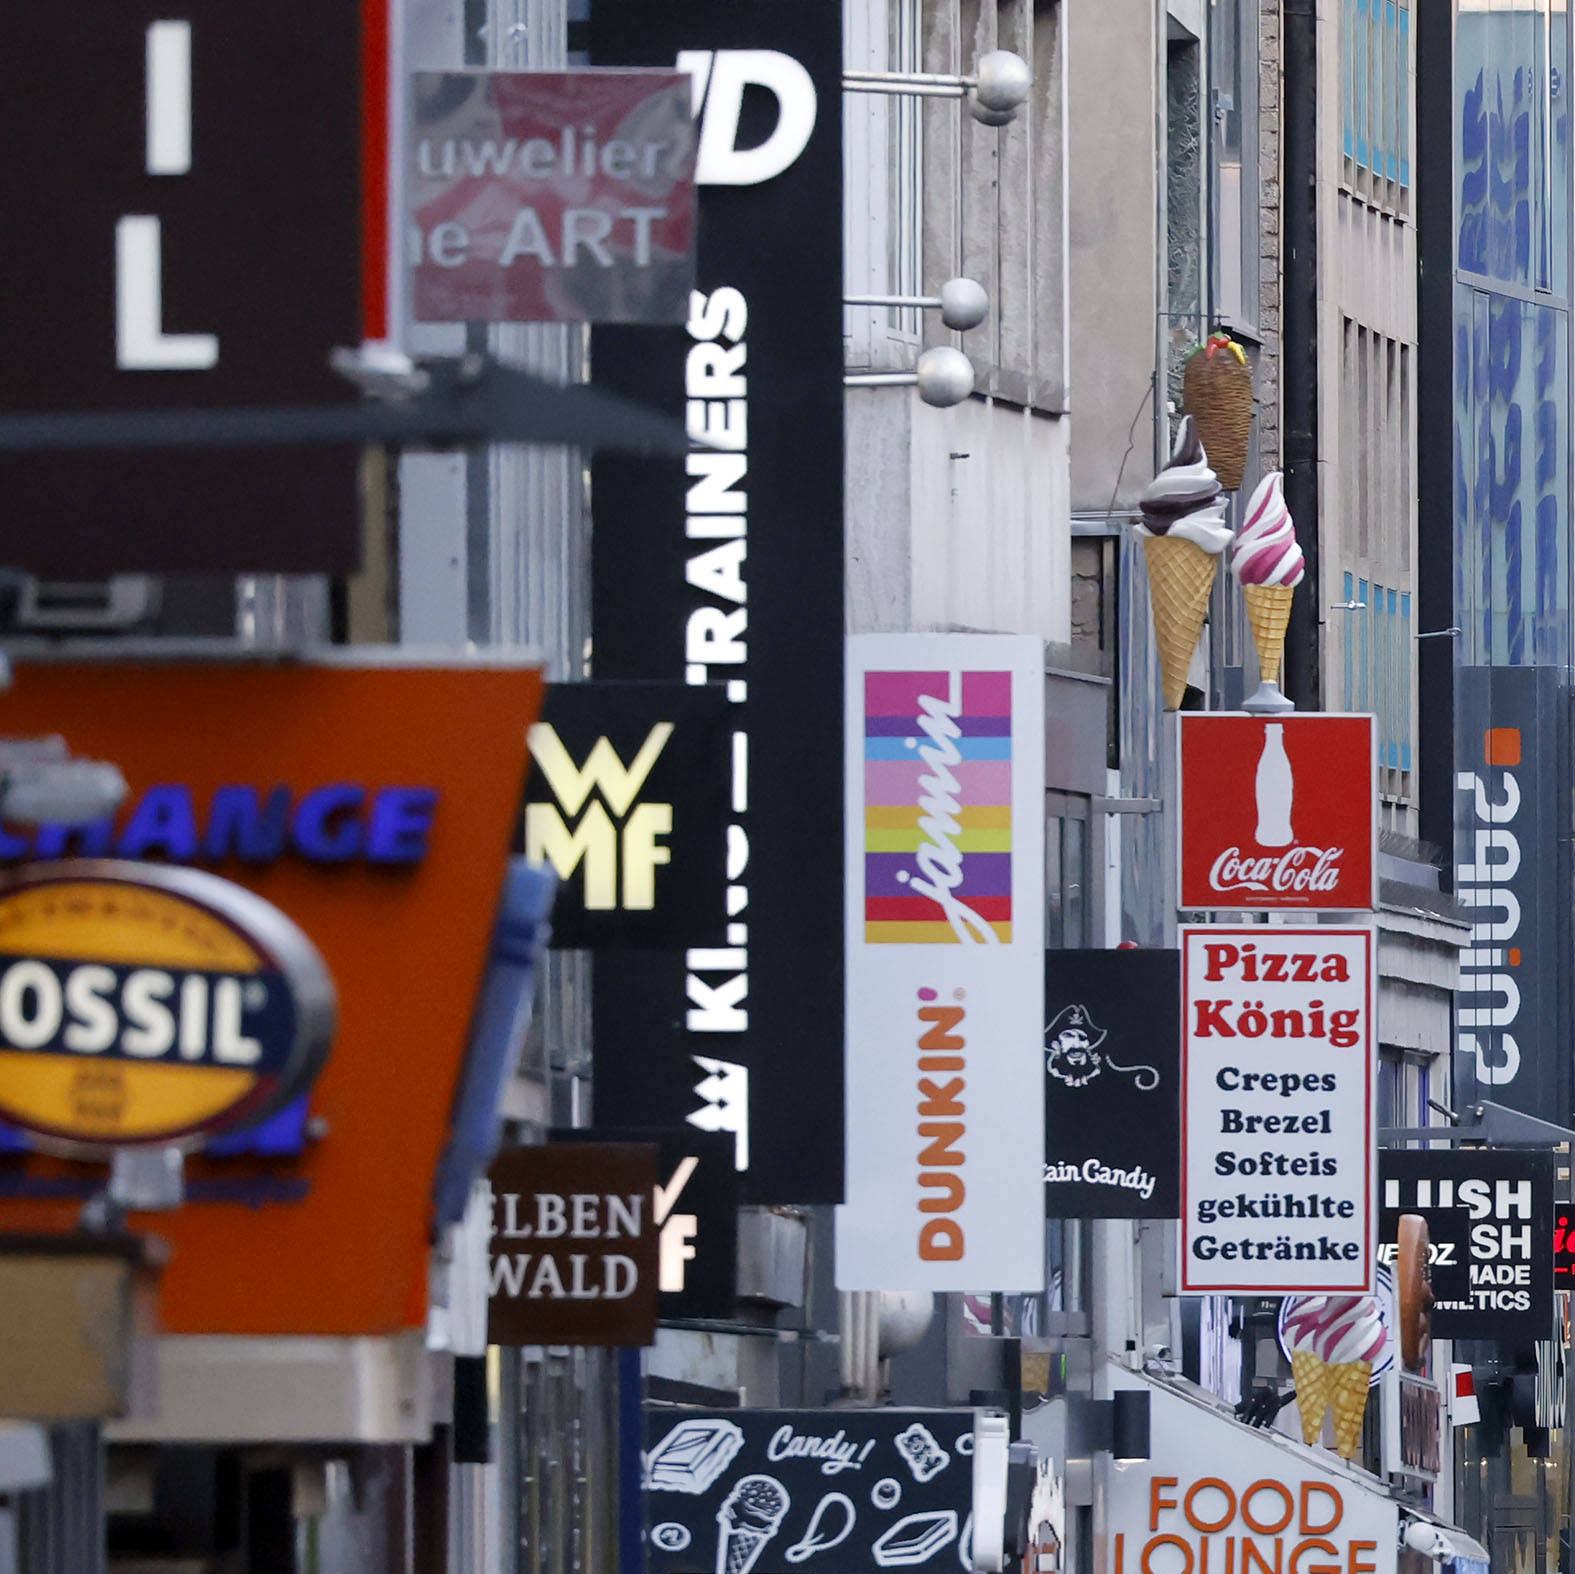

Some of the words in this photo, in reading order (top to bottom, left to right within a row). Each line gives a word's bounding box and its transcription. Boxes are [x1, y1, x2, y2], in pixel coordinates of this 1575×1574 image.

[417, 125, 667, 178] uwelier
[498, 206, 668, 268] ART
[897, 672, 997, 945] jamin
[1208, 846, 1345, 892] Coca-Cola
[1203, 943, 1350, 983] Pizza
[0, 958, 262, 1065] OSSIL
[1193, 998, 1361, 1048] König
[1215, 1066, 1337, 1098] Crepes
[1219, 1108, 1333, 1135] Brezel
[1083, 1158, 1157, 1200] Candy
[1214, 1150, 1338, 1177] Softeis
[491, 1192, 645, 1240] LBEN
[1197, 1192, 1356, 1225] gekühlte
[1192, 1234, 1360, 1262] Getränke
[488, 1253, 639, 1299] WALD
[768, 1425, 876, 1476] Candy!
[1149, 1476, 1344, 1535] FOOD
